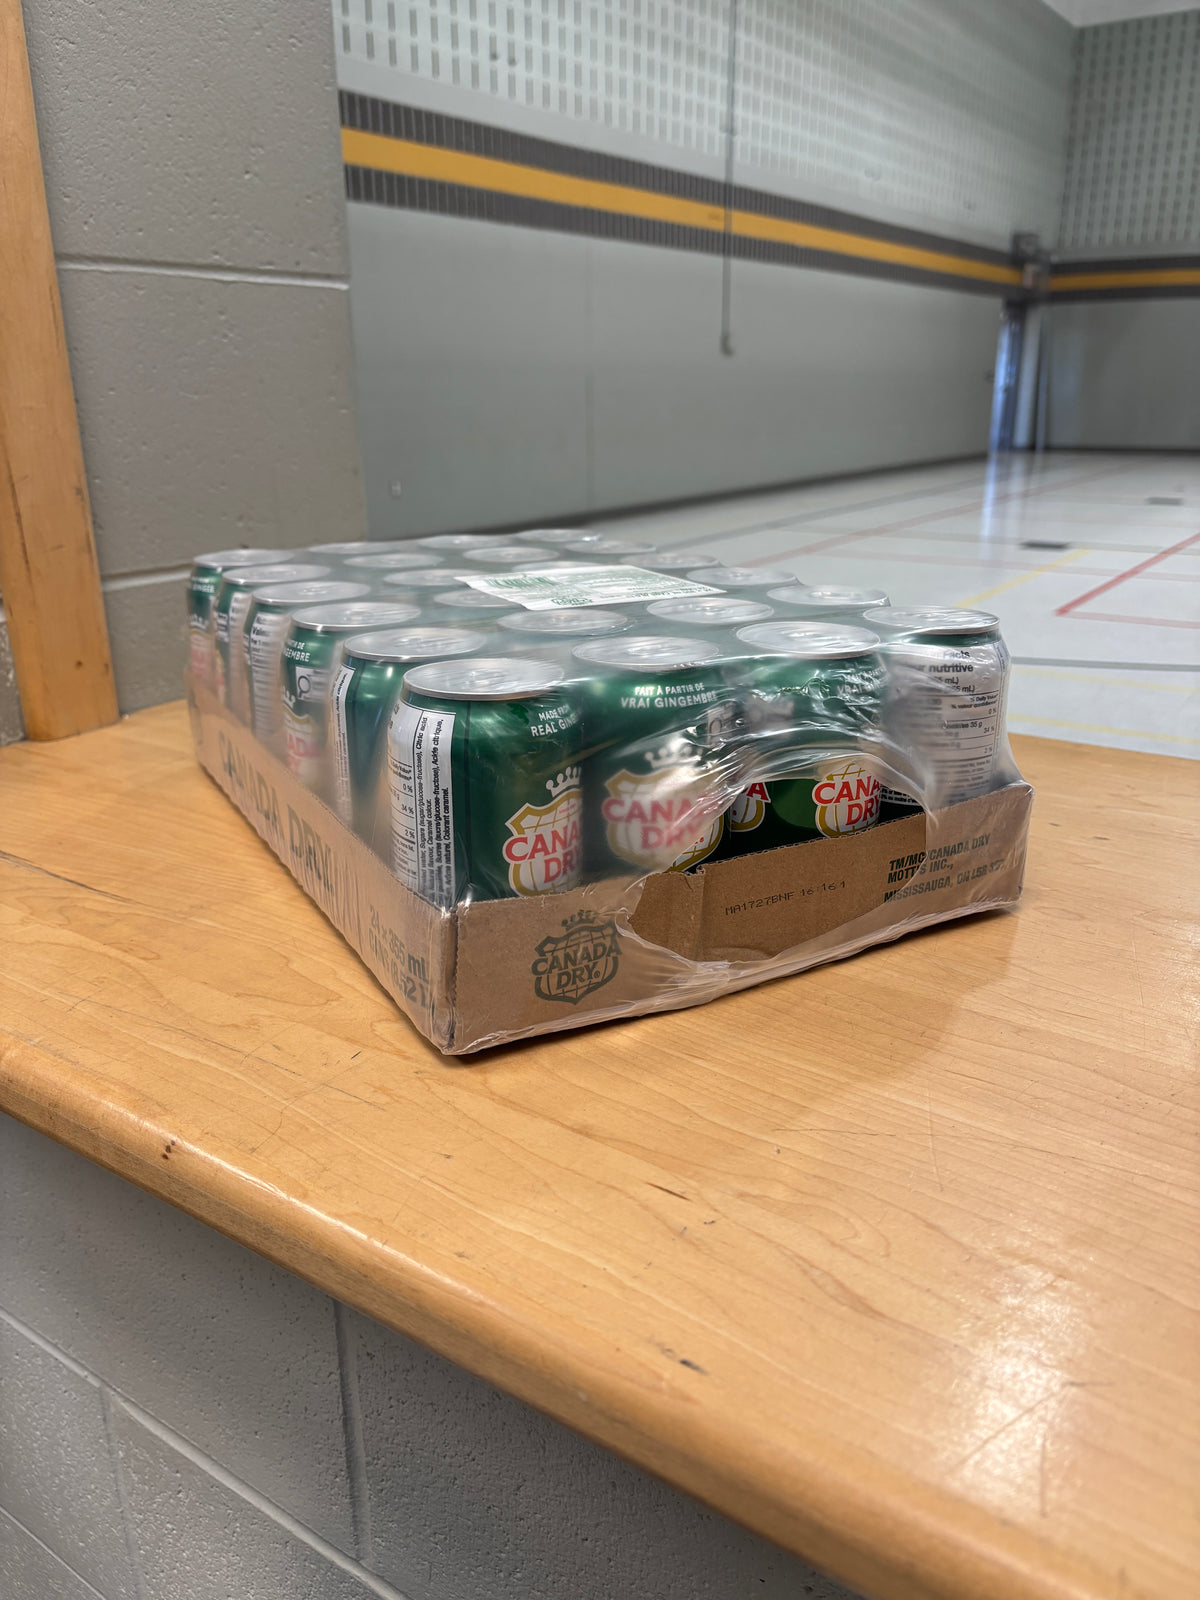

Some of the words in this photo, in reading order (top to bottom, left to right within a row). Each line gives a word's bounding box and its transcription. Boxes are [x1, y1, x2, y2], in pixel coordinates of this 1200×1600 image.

[929, 663, 973, 672] nutritive
[620, 697, 650, 708] VRAI
[654, 691, 718, 708] GINGEMBRE
[634, 686, 655, 696] FAIT
[656, 685, 664, 695] À
[665, 685, 694, 694] PARTIR
[694, 682, 705, 691] DE
[962, 685, 975, 693] mL)
[538, 709, 558, 721] MADE
[416, 733, 424, 750] Citric
[420, 717, 428, 732] acid
[432, 719, 444, 746] citrique,
[530, 721, 558, 737] REAL
[442, 787, 450, 814] caramel.
[814, 775, 880, 804] CANA
[442, 815, 450, 840] Colorant
[505, 819, 580, 862] CANA
[889, 851, 927, 871] TM/MC
[928, 840, 969, 860] CANADA
[971, 833, 992, 850] DRY
[544, 849, 579, 883] DR
[887, 864, 927, 884] MOTT'S
[884, 876, 954, 903] MISSISSAUGA,
[388, 927, 406, 968] 355
[531, 935, 622, 976] CANADA
